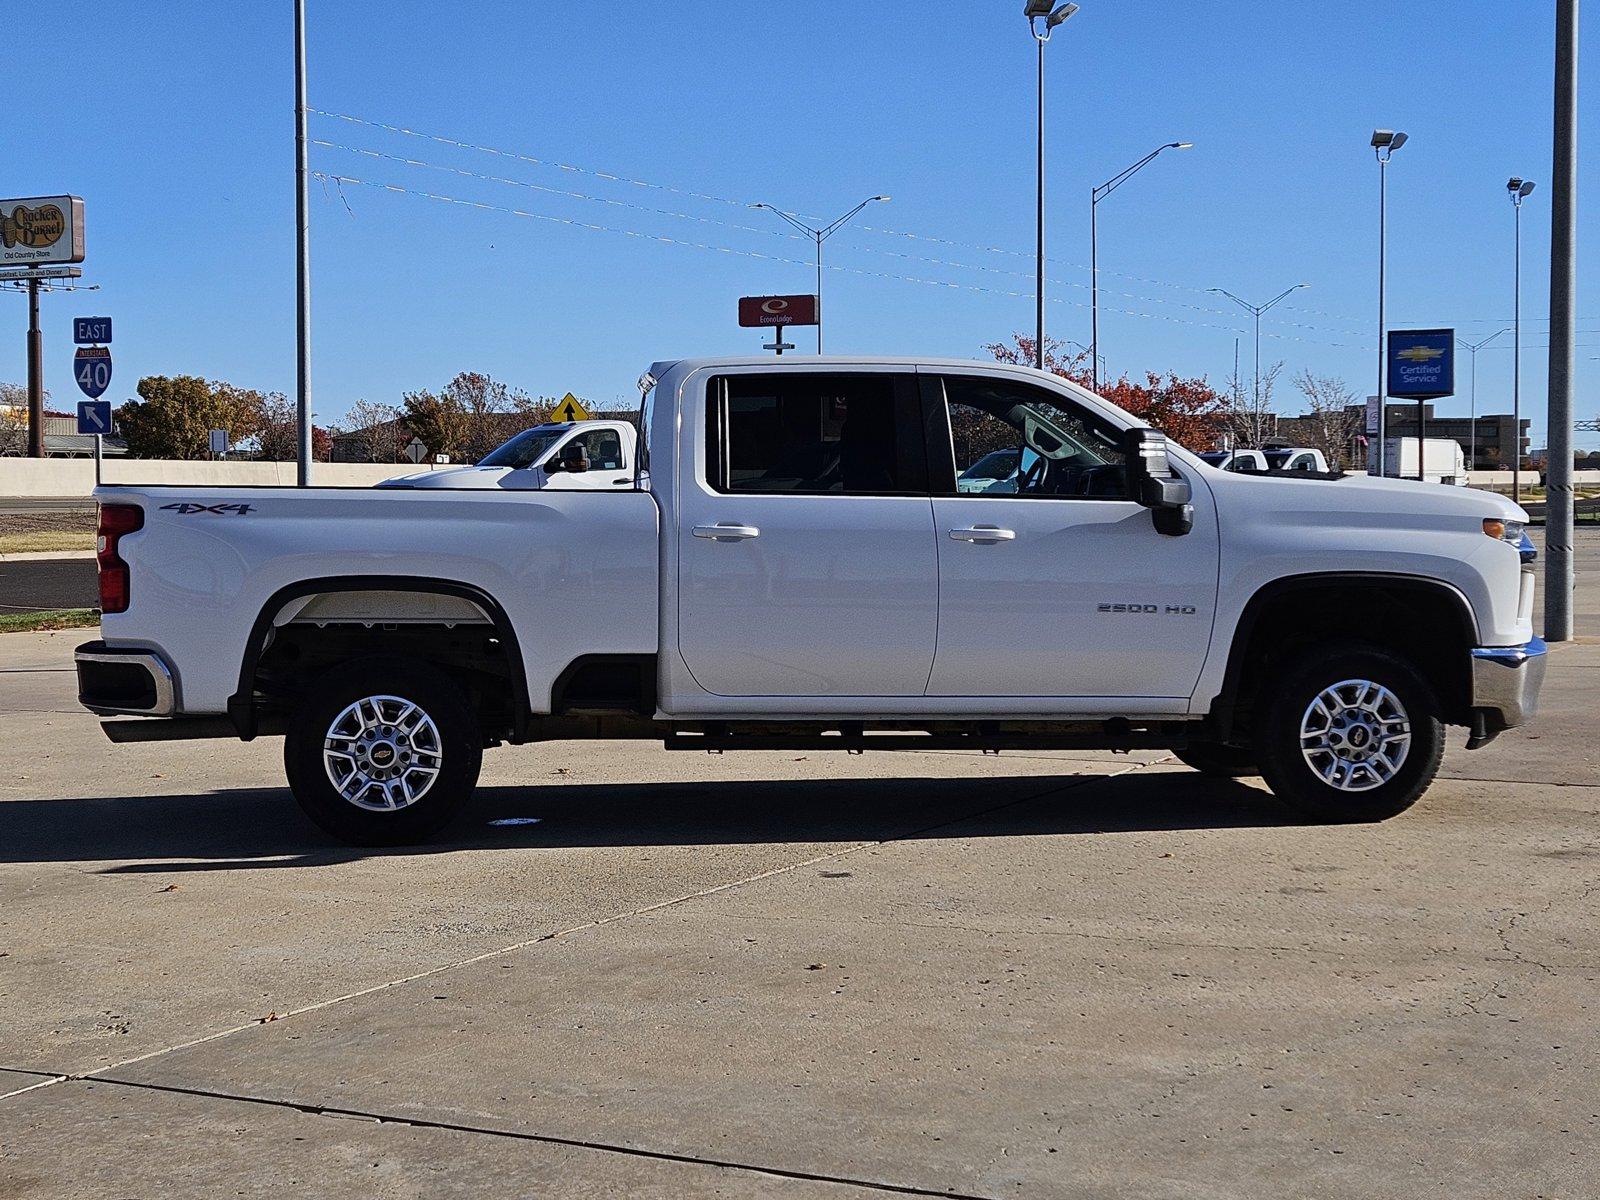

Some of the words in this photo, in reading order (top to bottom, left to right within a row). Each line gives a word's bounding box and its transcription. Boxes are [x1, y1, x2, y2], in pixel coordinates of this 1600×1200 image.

[14, 251, 35, 259] Country
[78, 322, 107, 339] EAST
[1400, 365, 1441, 374] Certified
[78, 363, 109, 389] 40
[1403, 374, 1438, 383] Service
[1097, 603, 1158, 614] 2500
[1165, 604, 1196, 615] HD
